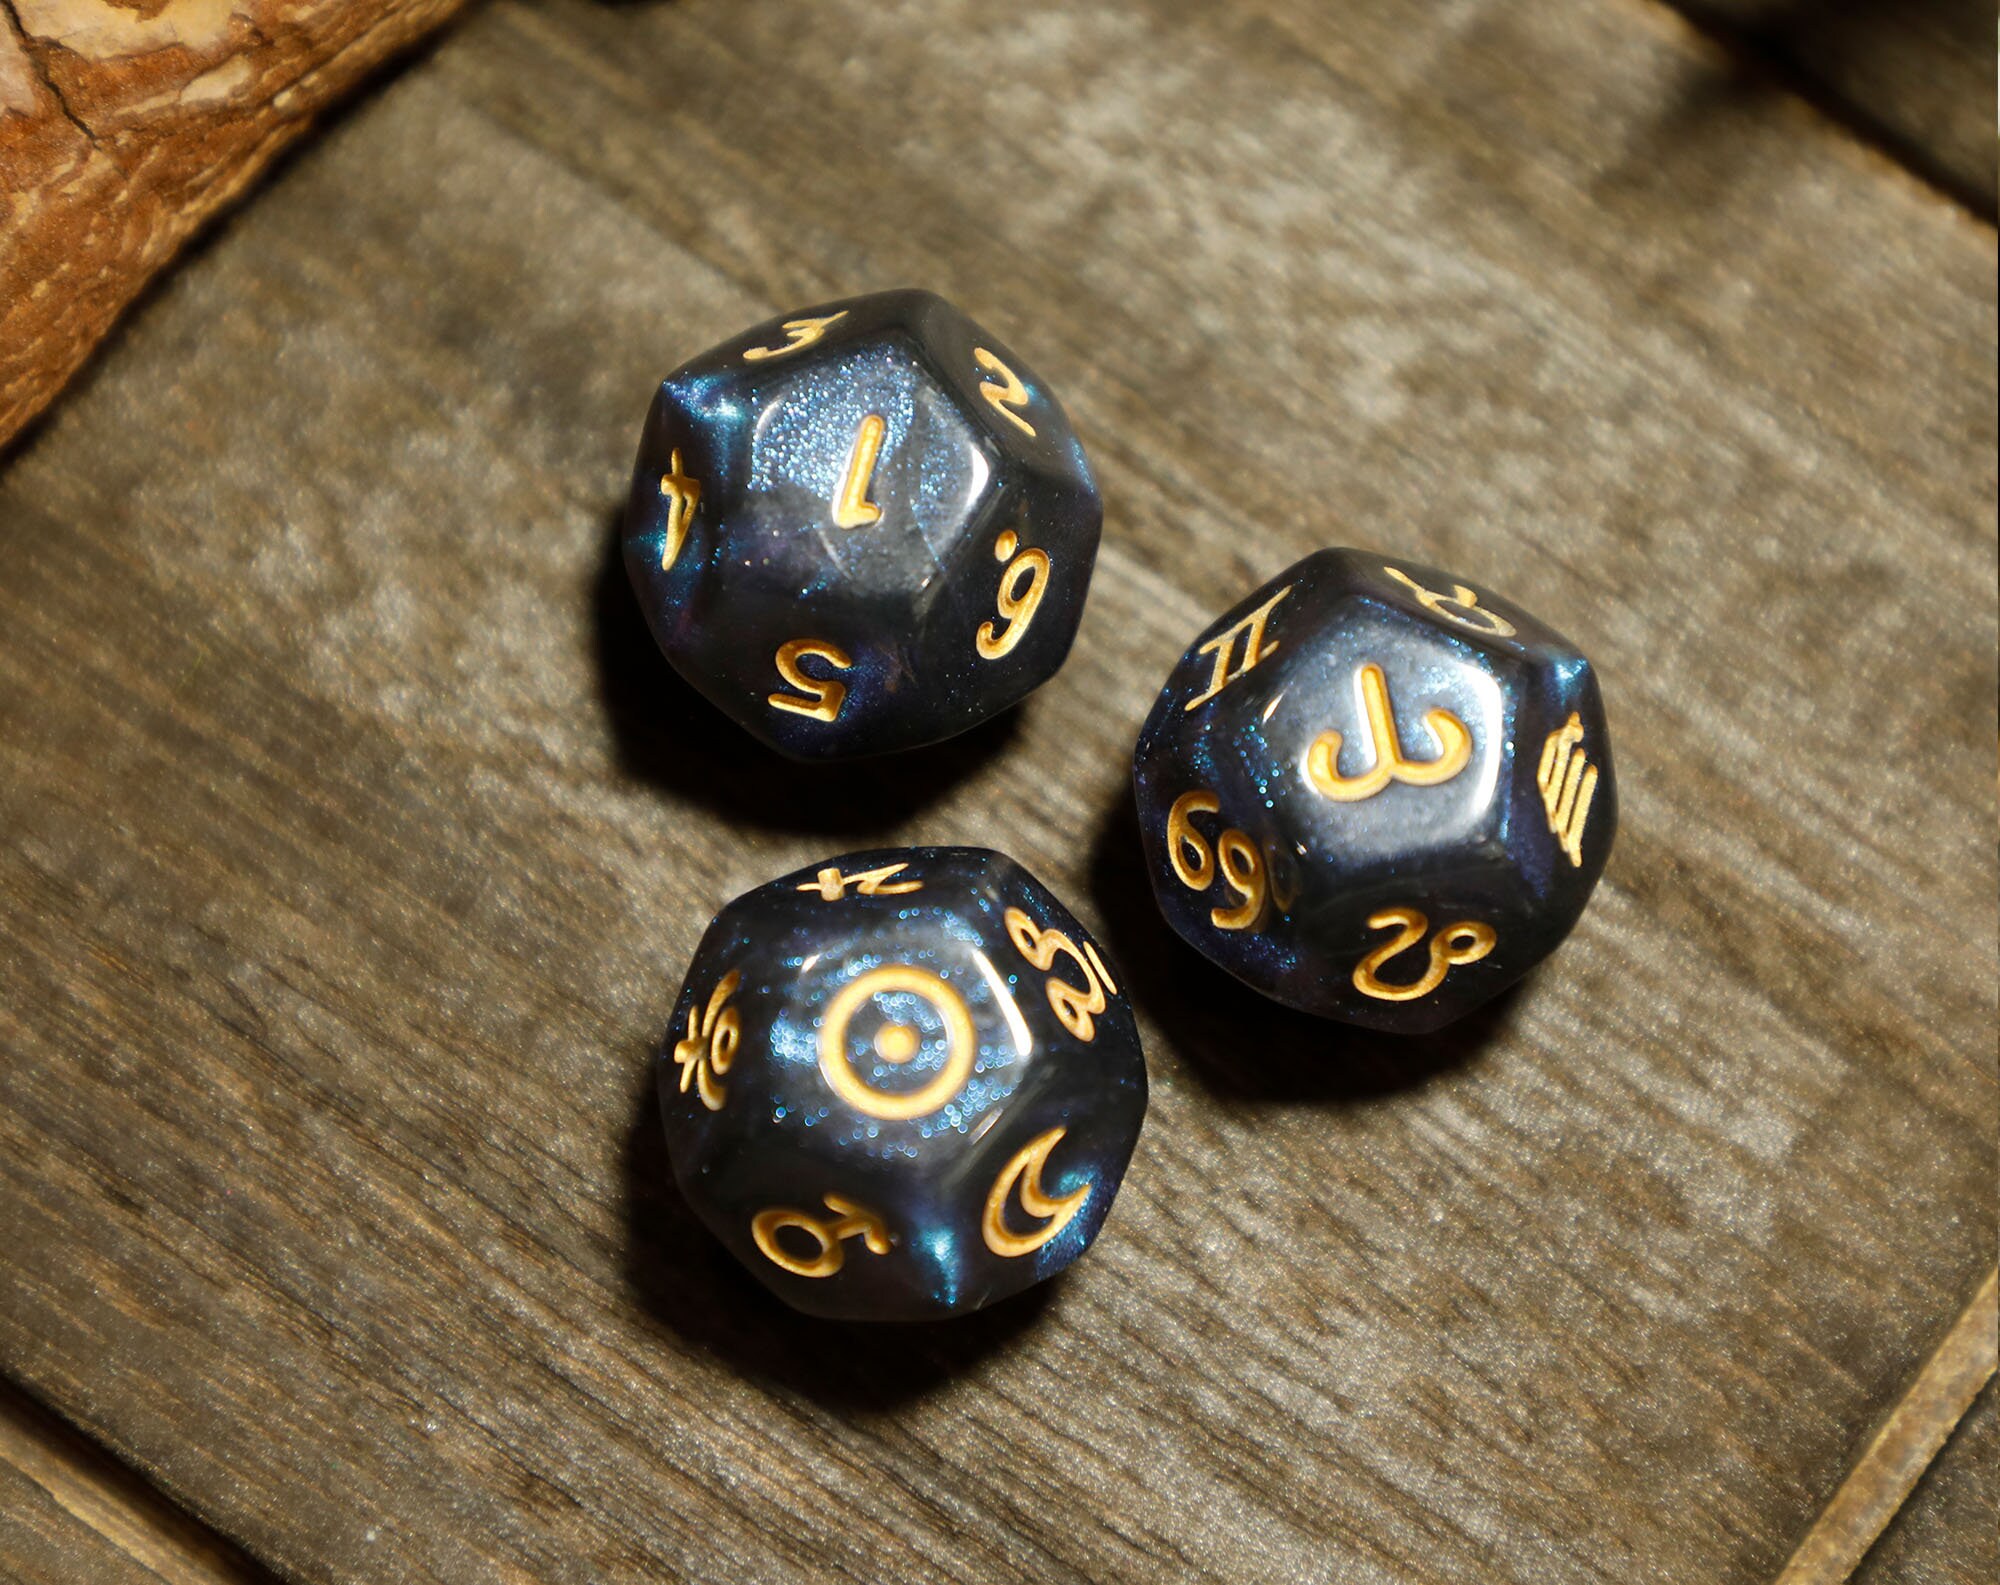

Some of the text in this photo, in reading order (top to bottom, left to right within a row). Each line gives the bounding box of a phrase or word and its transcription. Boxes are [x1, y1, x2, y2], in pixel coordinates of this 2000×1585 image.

[743, 310, 849, 361] 3
[974, 347, 1037, 437] 2
[660, 447, 700, 571] 4
[834, 414, 885, 529] 1
[768, 638, 852, 722] 5
